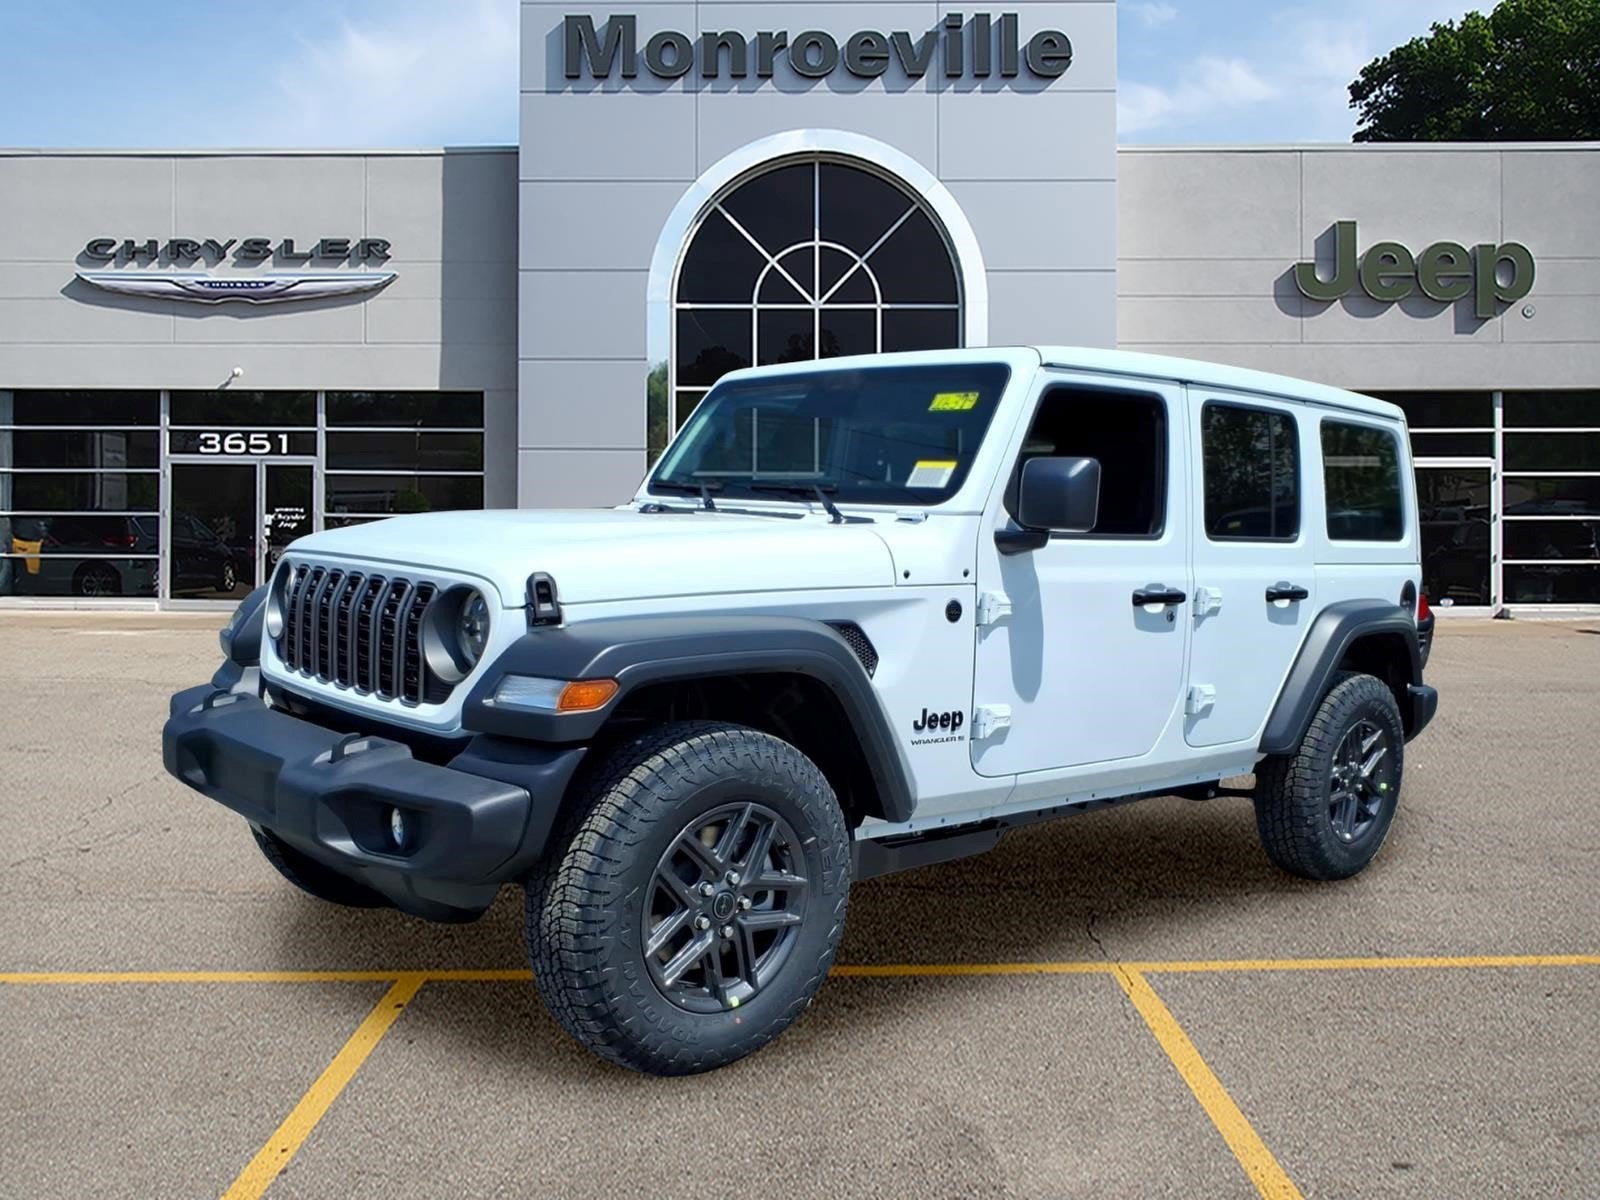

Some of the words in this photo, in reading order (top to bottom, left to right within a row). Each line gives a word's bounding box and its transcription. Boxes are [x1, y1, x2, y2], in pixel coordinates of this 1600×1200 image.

[564, 13, 1074, 79] Monroeville
[86, 238, 393, 260] CHRYSLER
[1295, 221, 1536, 318] Jeep
[199, 433, 289, 455] 3651
[912, 707, 964, 732] Jeep
[910, 736, 957, 747] WRANGLER
